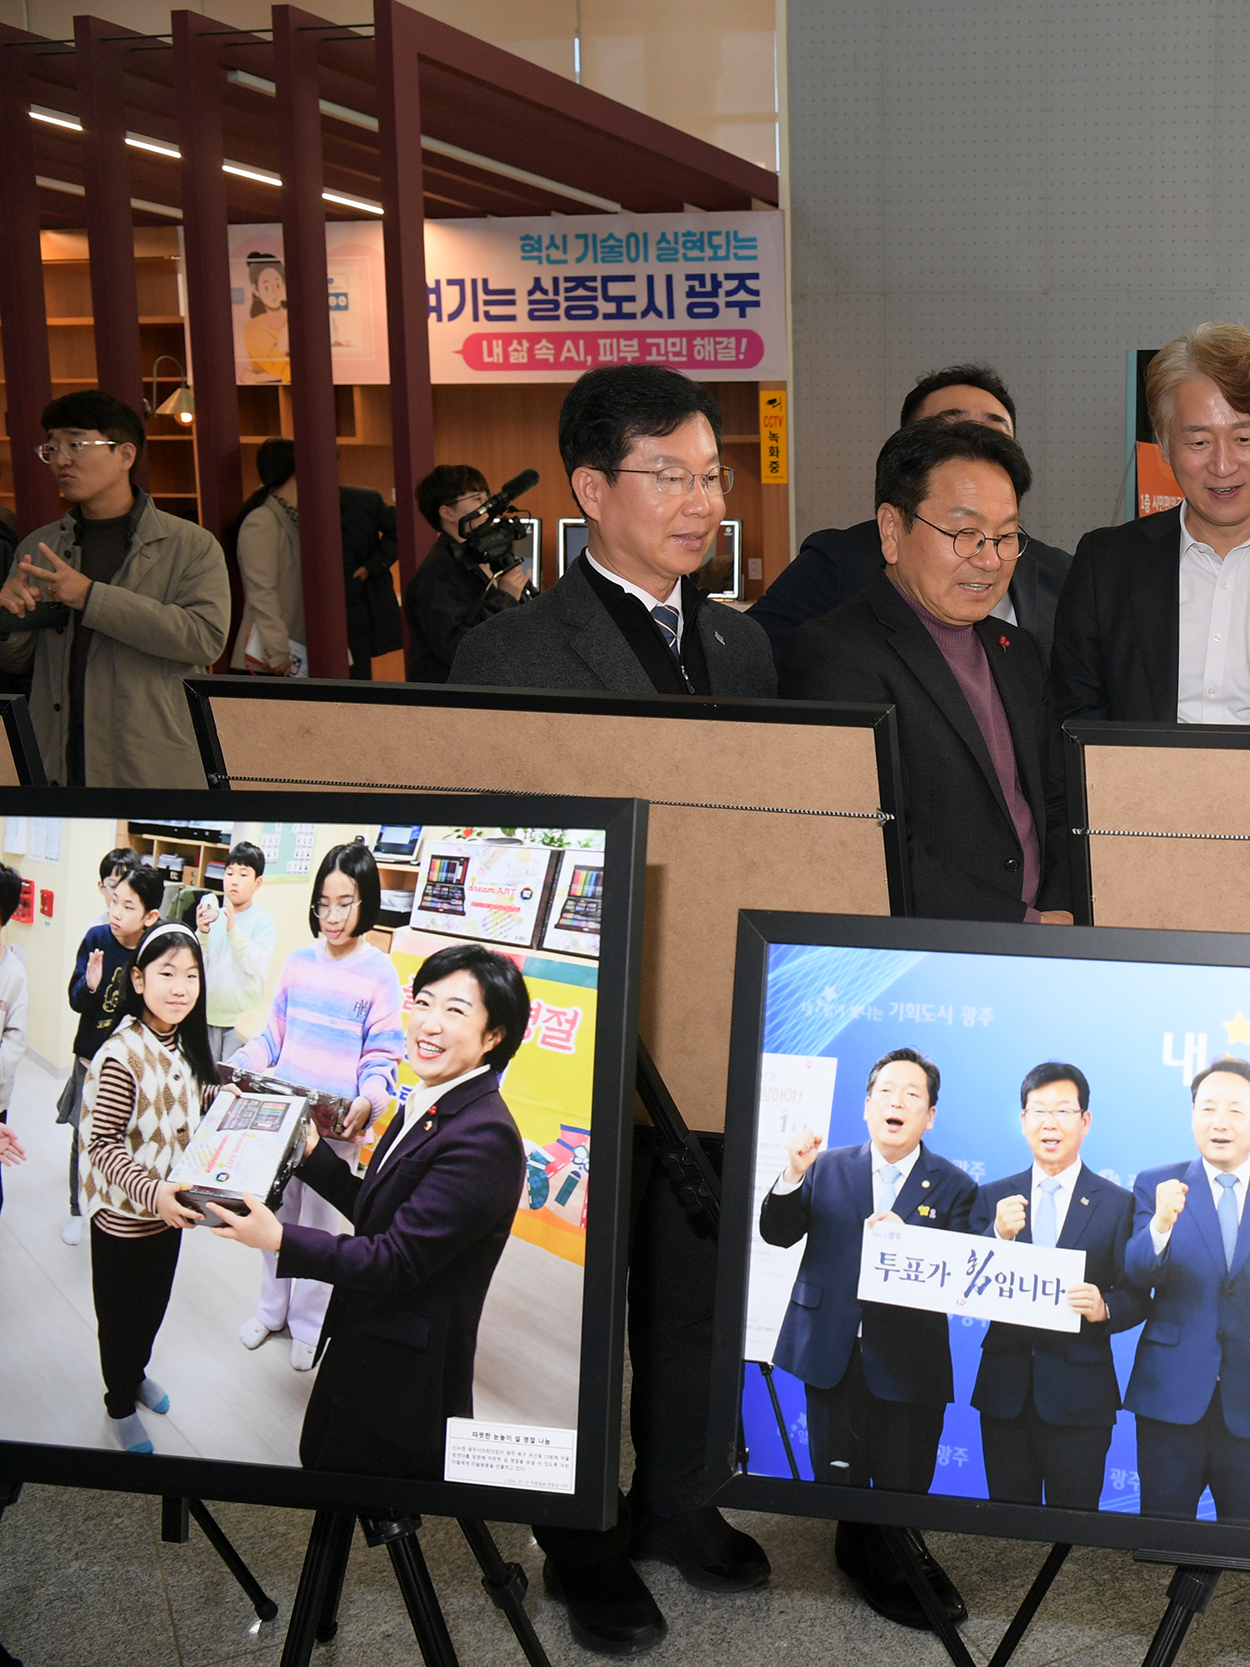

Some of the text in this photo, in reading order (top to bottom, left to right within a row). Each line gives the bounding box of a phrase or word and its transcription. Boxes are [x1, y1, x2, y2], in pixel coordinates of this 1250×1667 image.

[520, 230, 758, 265] 혁신 기술이 실현되는
[527, 274, 675, 322] 실증도시
[684, 272, 761, 320] 광주
[482, 335, 748, 366] 내 삶 속 AI, 피부 고민 해결!
[763, 415, 783, 428] CCTV
[889, 1001, 954, 1026] 기회도시
[960, 1005, 995, 1028] 광주
[874, 1251, 952, 1288] 투표가
[472, 1431, 491, 1440] 따뜻한
